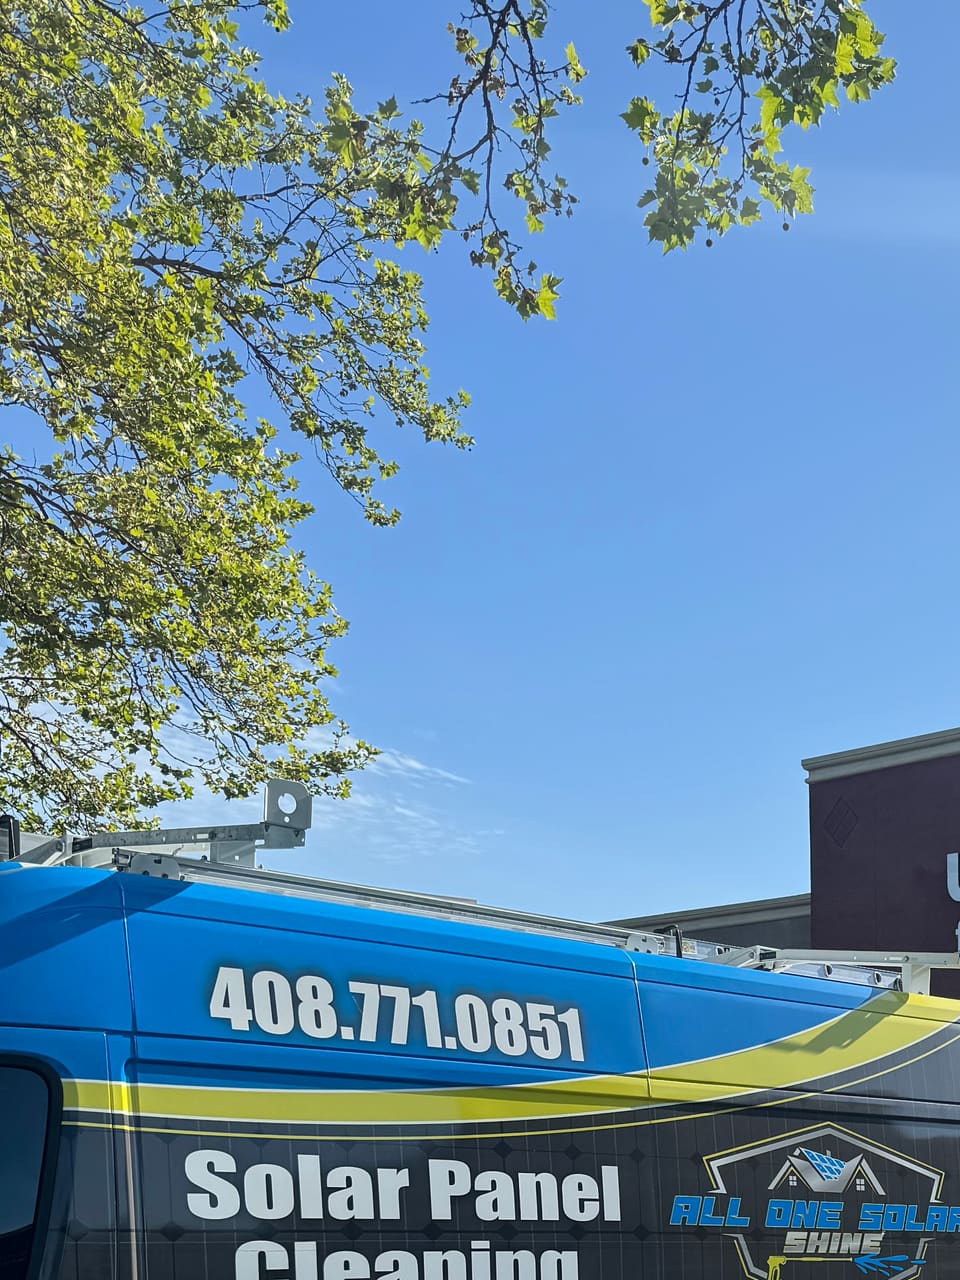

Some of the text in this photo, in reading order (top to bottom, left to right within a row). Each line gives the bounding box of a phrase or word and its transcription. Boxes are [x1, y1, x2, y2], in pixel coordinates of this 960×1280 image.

[209, 966, 586, 1062] 408.771.0851
[185, 1149, 622, 1222] Solar Panel
[669, 1195, 750, 1227] ALL
[765, 1199, 844, 1229] ONE
[783, 1231, 886, 1254] SHINE
